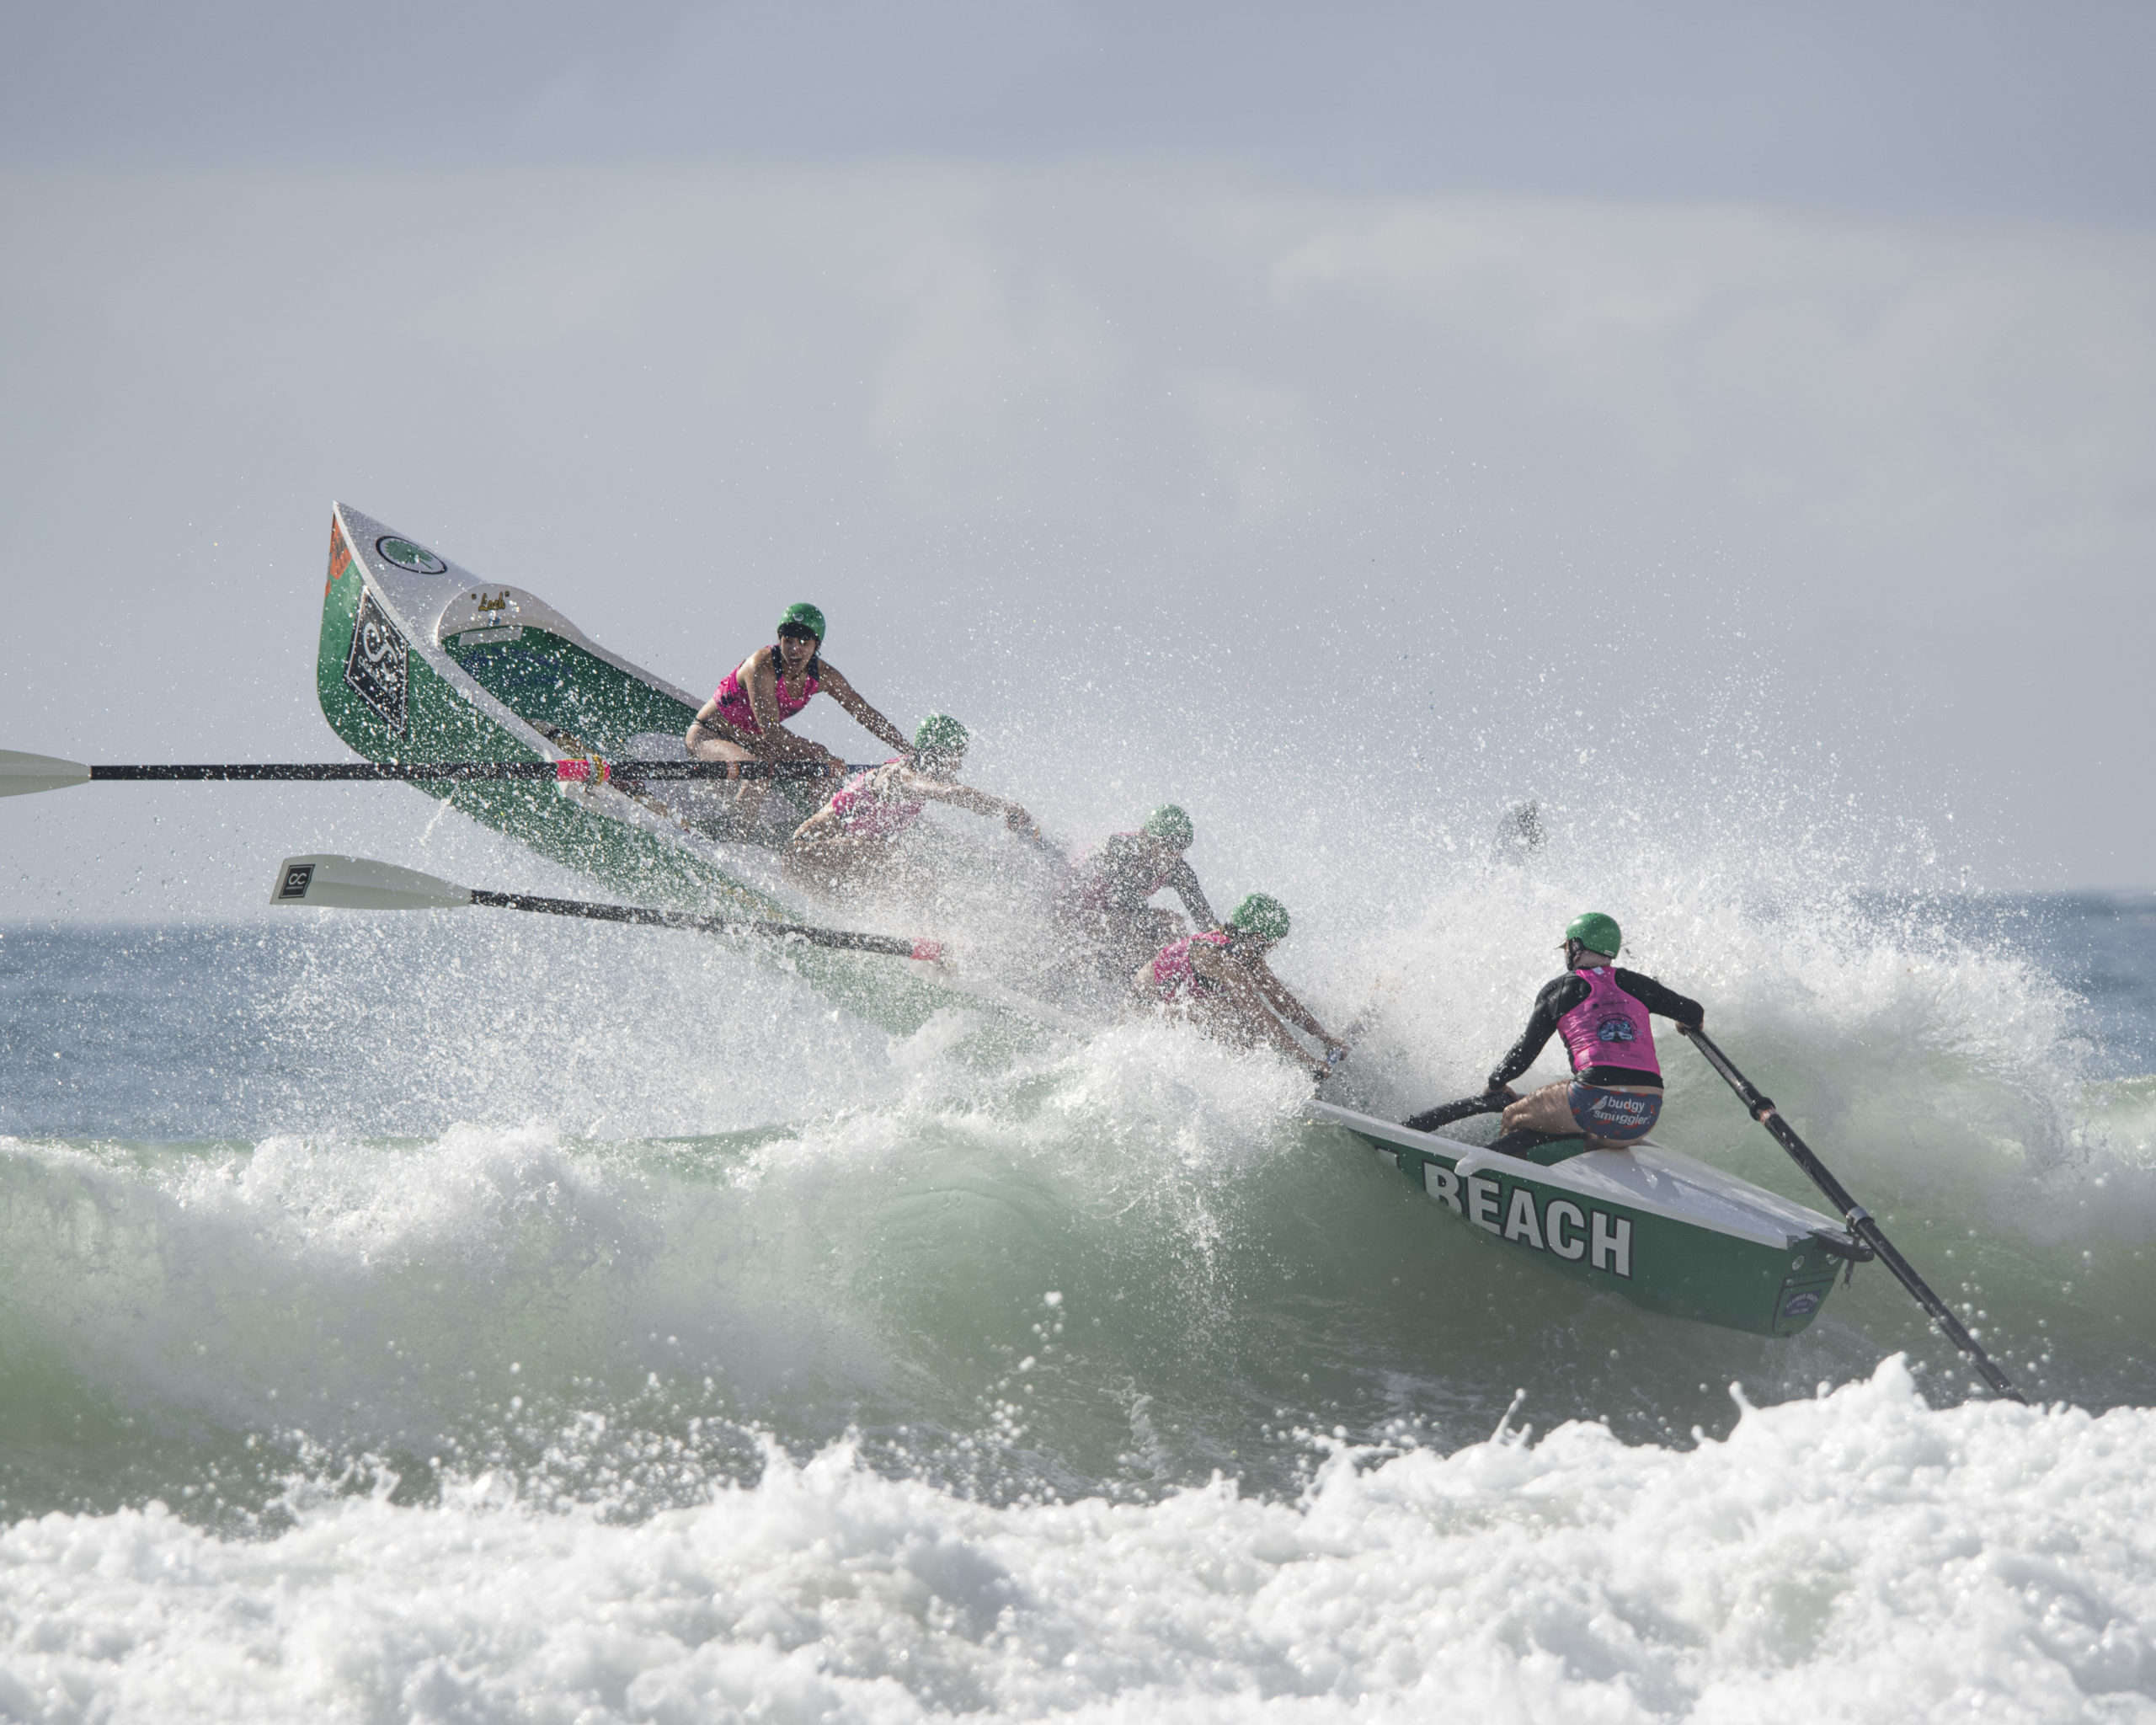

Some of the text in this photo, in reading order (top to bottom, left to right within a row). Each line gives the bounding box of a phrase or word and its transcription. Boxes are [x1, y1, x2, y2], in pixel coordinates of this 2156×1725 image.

[1608, 1096, 1645, 1113] budgy
[1593, 1110, 1648, 1125] smuggler
[1422, 1161, 1632, 1279] BEACH
